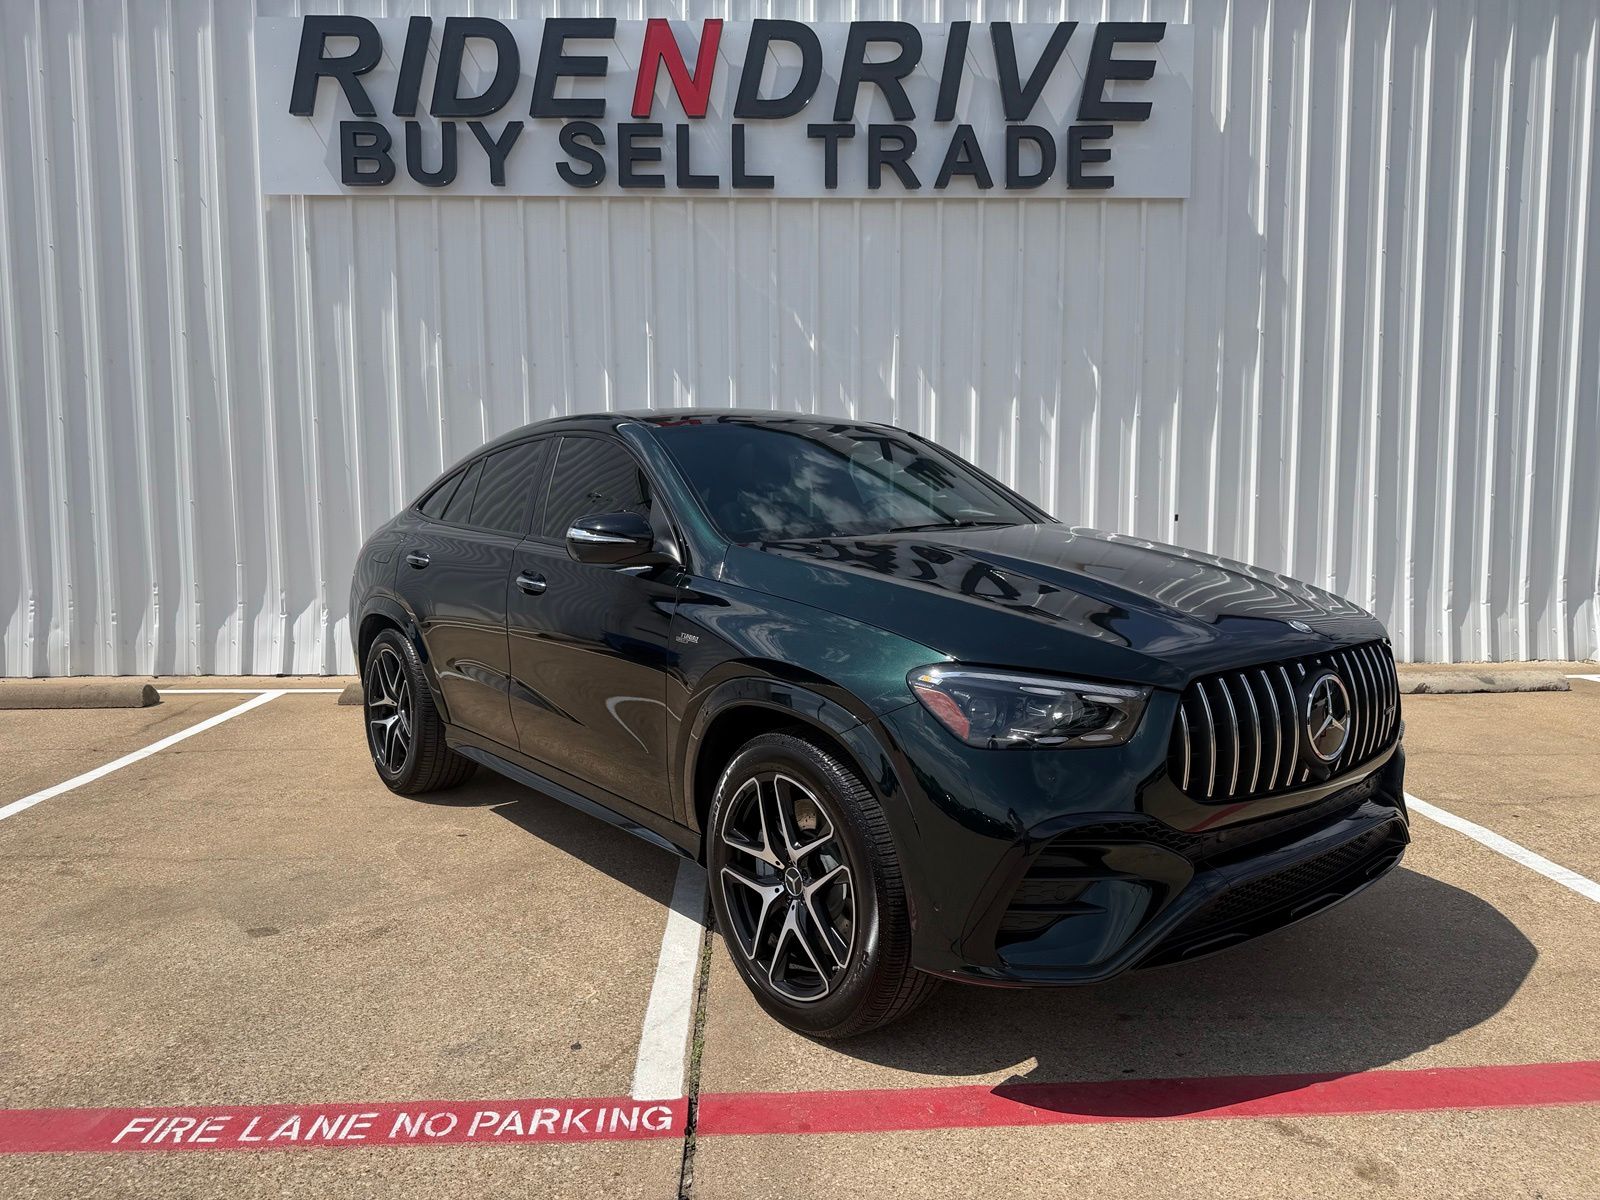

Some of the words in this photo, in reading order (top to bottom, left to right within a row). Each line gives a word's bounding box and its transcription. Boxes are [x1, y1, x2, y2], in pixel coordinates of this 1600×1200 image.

[339, 120, 524, 188] BUY
[555, 120, 775, 190] SELL
[807, 124, 1115, 190] TRADE
[111, 1116, 233, 1144] FIRE
[237, 1112, 380, 1142] LANE
[388, 1111, 458, 1138] NO
[466, 1105, 673, 1137] PARKING
